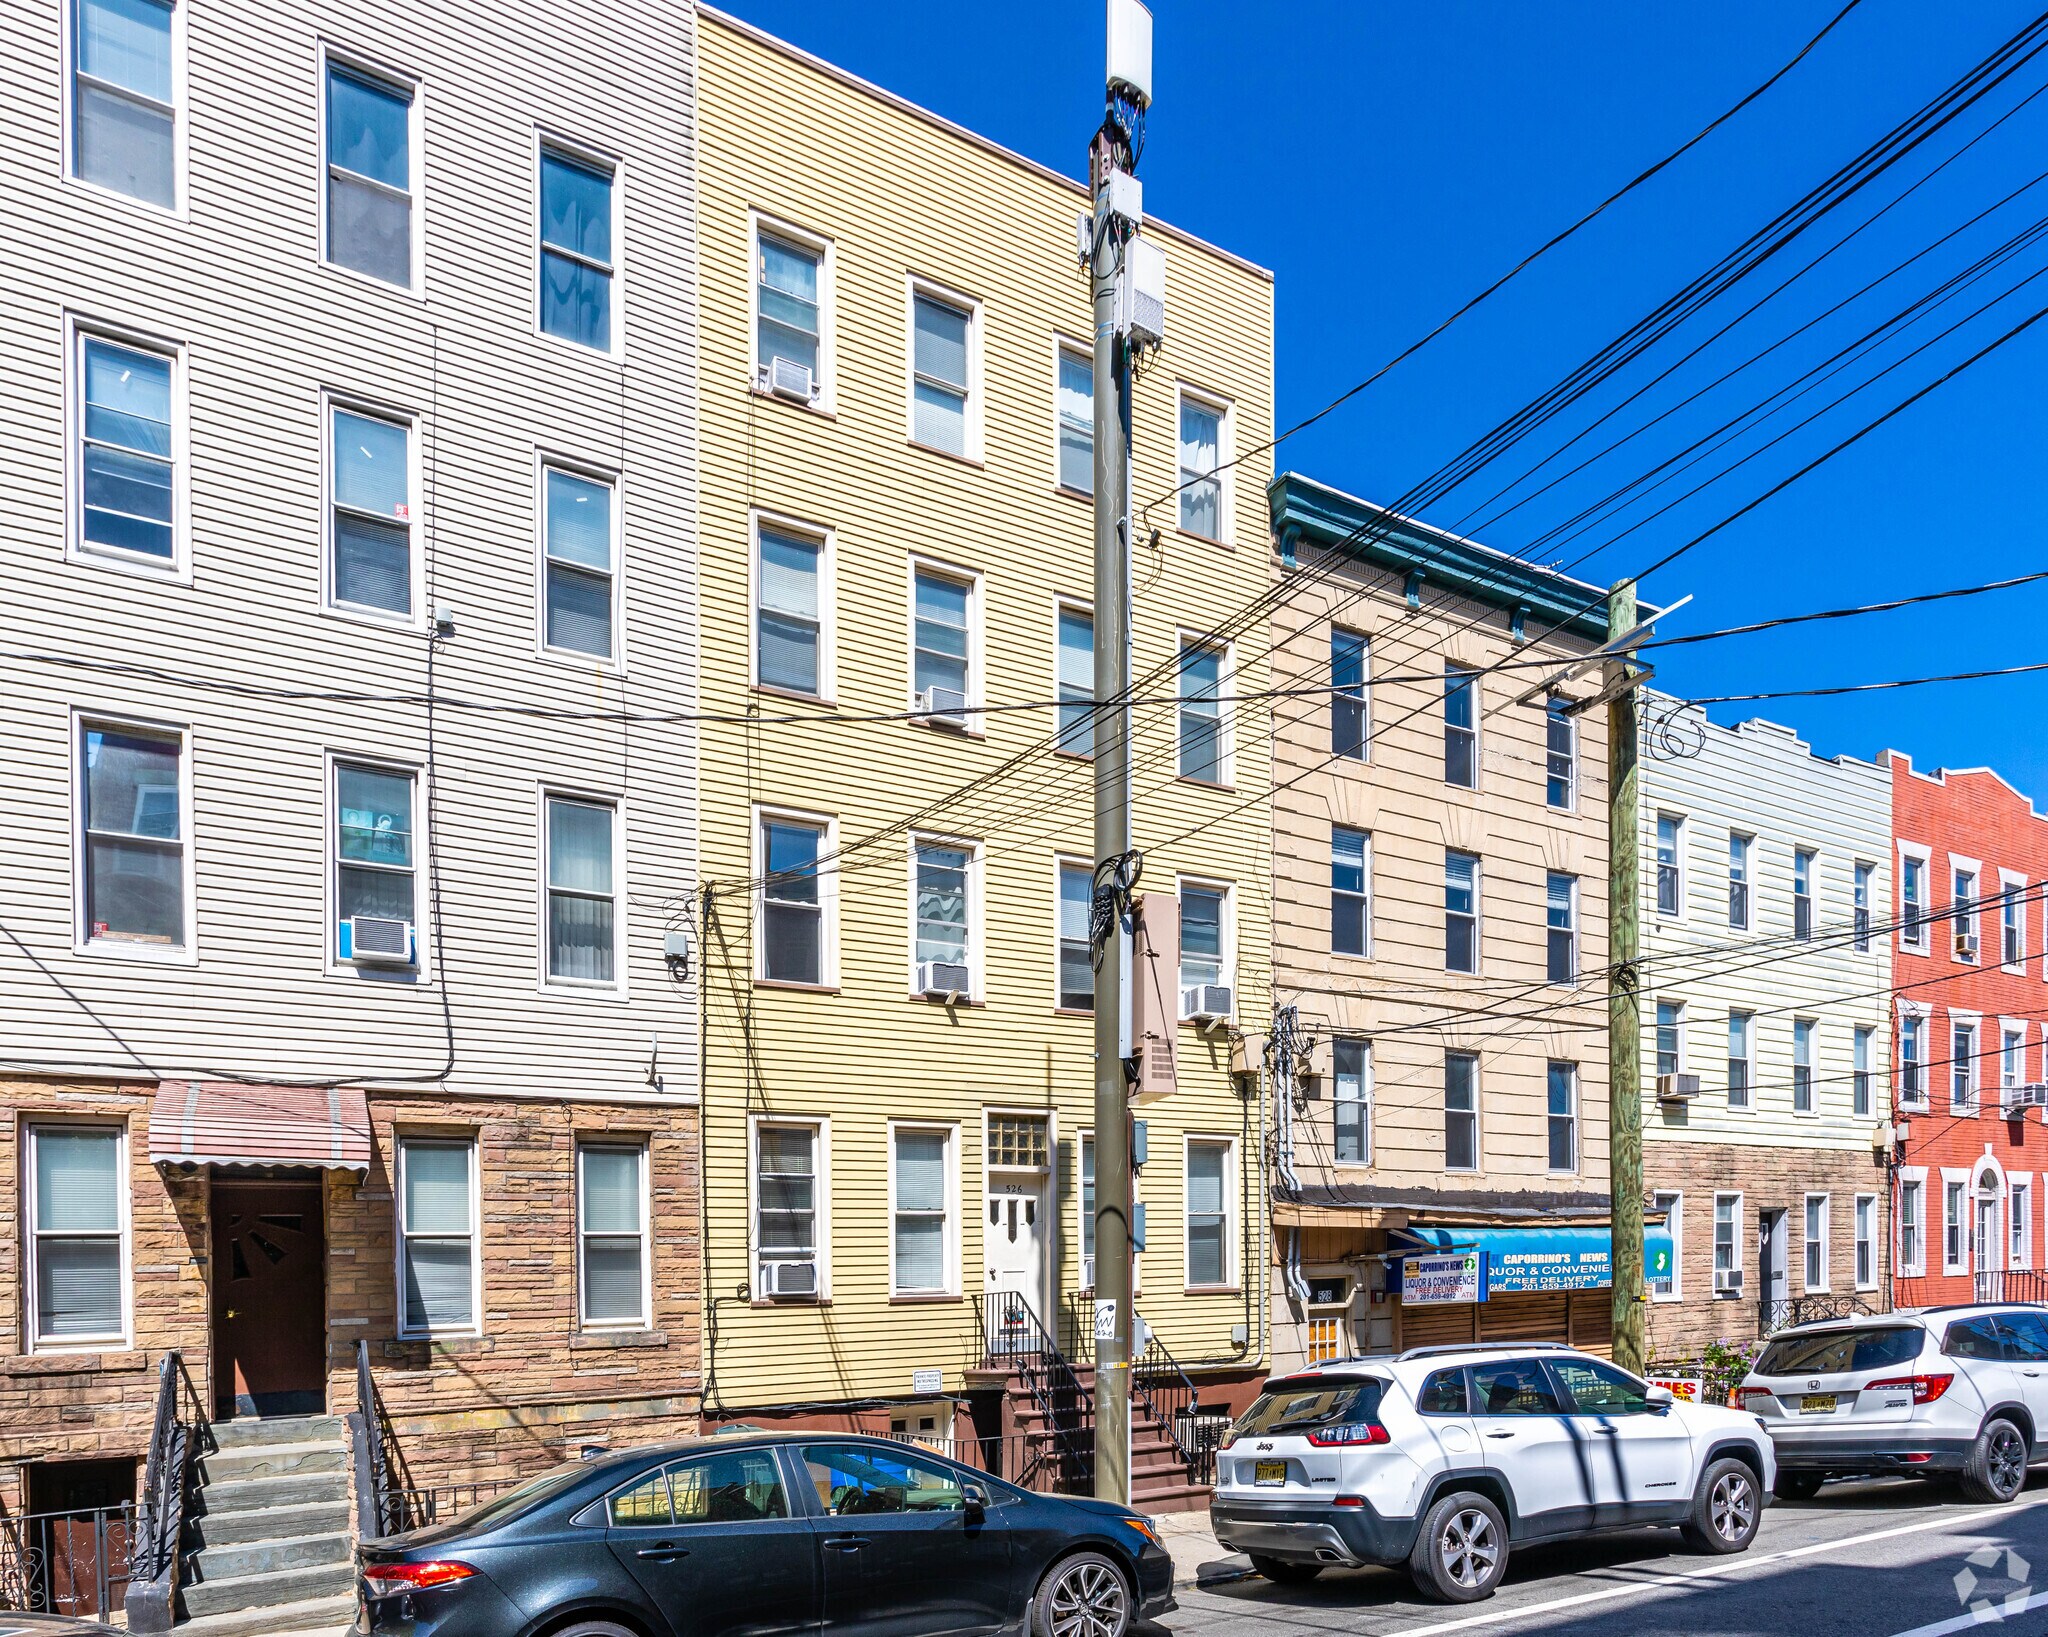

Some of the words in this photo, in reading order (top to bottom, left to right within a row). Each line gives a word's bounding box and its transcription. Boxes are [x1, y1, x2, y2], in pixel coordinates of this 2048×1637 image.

[1503, 1254, 1571, 1264] CAPORRINO'S
[1580, 1252, 1608, 1263] NEWS
[1420, 1261, 1450, 1273] CAPORRINO'S
[1450, 1260, 1464, 1271] NEWS
[1529, 1266, 1539, 1275] &
[1541, 1264, 1613, 1275] CONVENIE
[1405, 1278, 1427, 1289] LIQUOR
[1428, 1277, 1432, 1287] &
[1433, 1275, 1475, 1287] CONVENIENCE
[1505, 1277, 1538, 1285] FREE
[1540, 1274, 1599, 1284] DELIVERY
[1645, 1275, 1672, 1283] LOTTERY
[1521, 1281, 1585, 1291] 201-659-4912
[1256, 1442, 1274, 1452] Jeep
